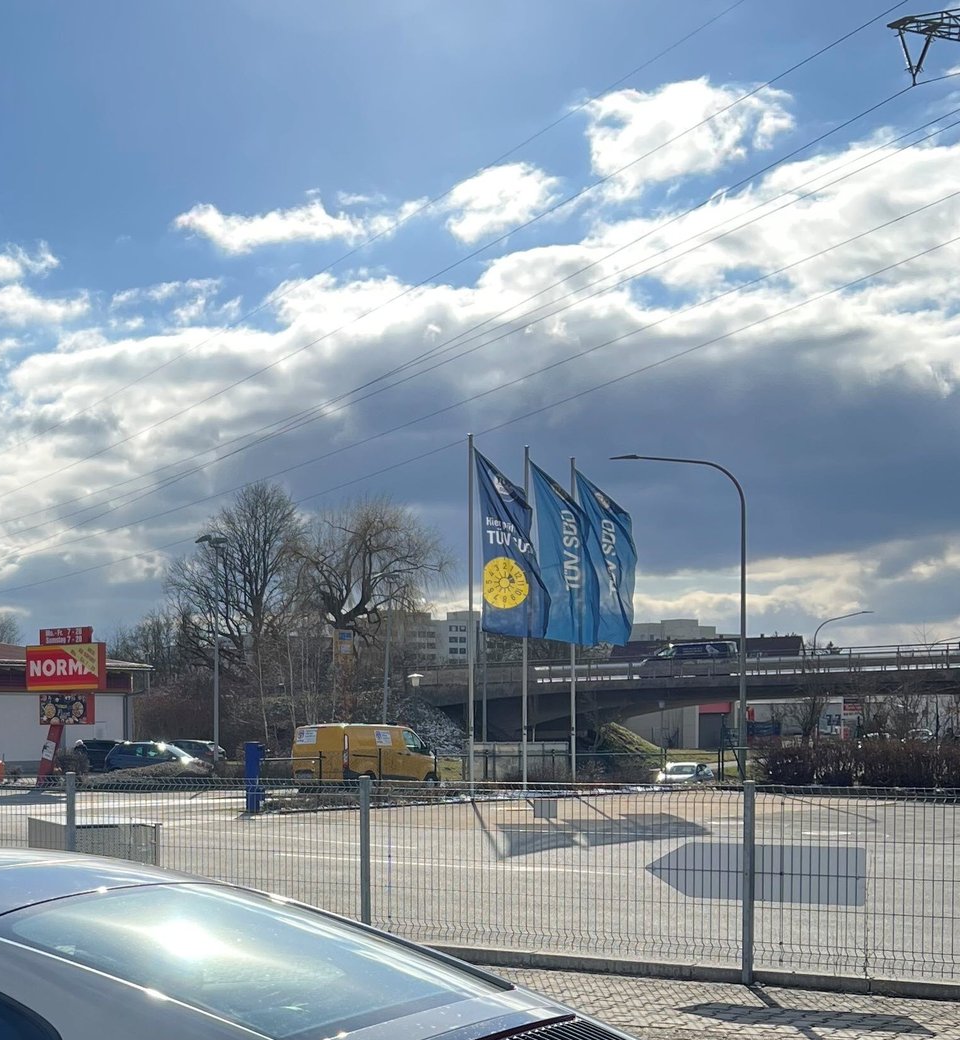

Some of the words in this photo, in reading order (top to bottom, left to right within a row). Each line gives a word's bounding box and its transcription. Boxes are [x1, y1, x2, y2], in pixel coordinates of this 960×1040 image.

[486, 527, 512, 546] TÜV
[560, 509, 581, 549] SÜD
[563, 549, 582, 593] TÜV
